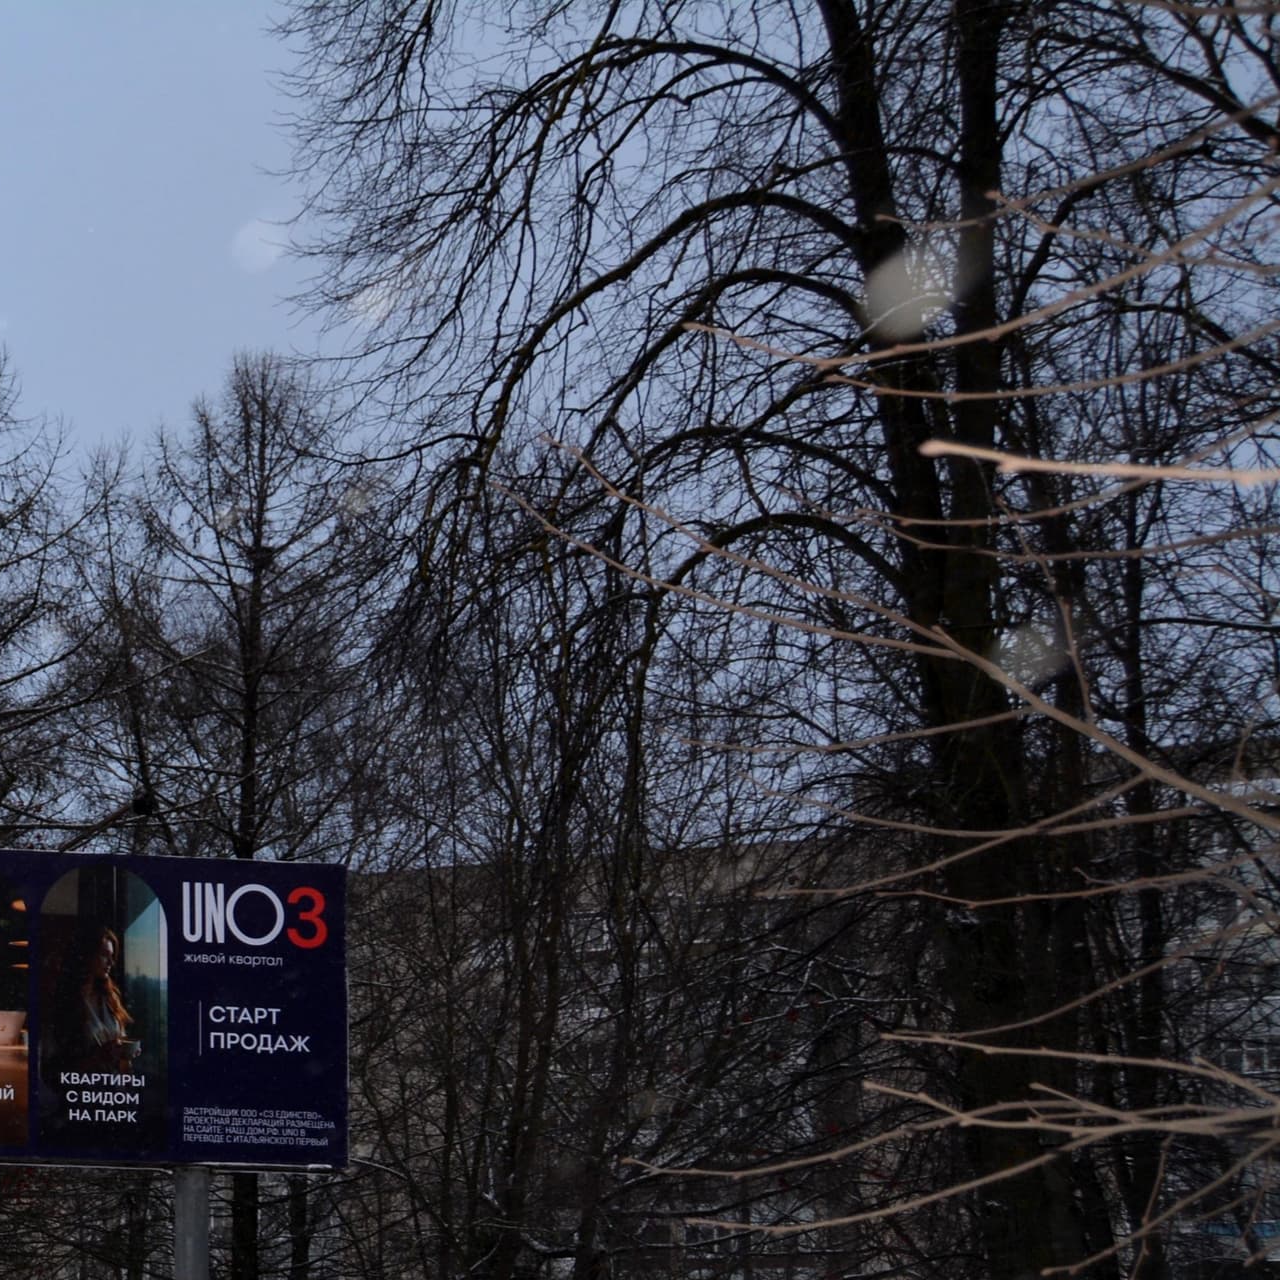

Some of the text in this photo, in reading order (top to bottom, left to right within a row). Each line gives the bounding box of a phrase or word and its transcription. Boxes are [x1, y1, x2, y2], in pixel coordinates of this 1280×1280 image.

[184, 952, 283, 968] живой квартал
[208, 1005, 281, 1025] СТАРТ
[209, 1031, 311, 1054] ПРОДАЖ
[60, 1071, 145, 1087] КВАРТИРЫ
[65, 1090, 140, 1106] С ВИДОМ
[68, 1108, 137, 1123] НА ПАРК
[241, 1109, 257, 1118] ООО
[183, 1116, 335, 1129] ПРОЕКТНАЯ ДЕКЛАРАЦИЯ РАЗМЕЩЕНА
[183, 1125, 195, 1133] НА
[183, 1134, 224, 1144] ПЕРЕВОДЕ
[232, 1135, 295, 1145] ИТАЛЬЯНСКОГО
[295, 1137, 329, 1146] ПЕРВЫЙ
